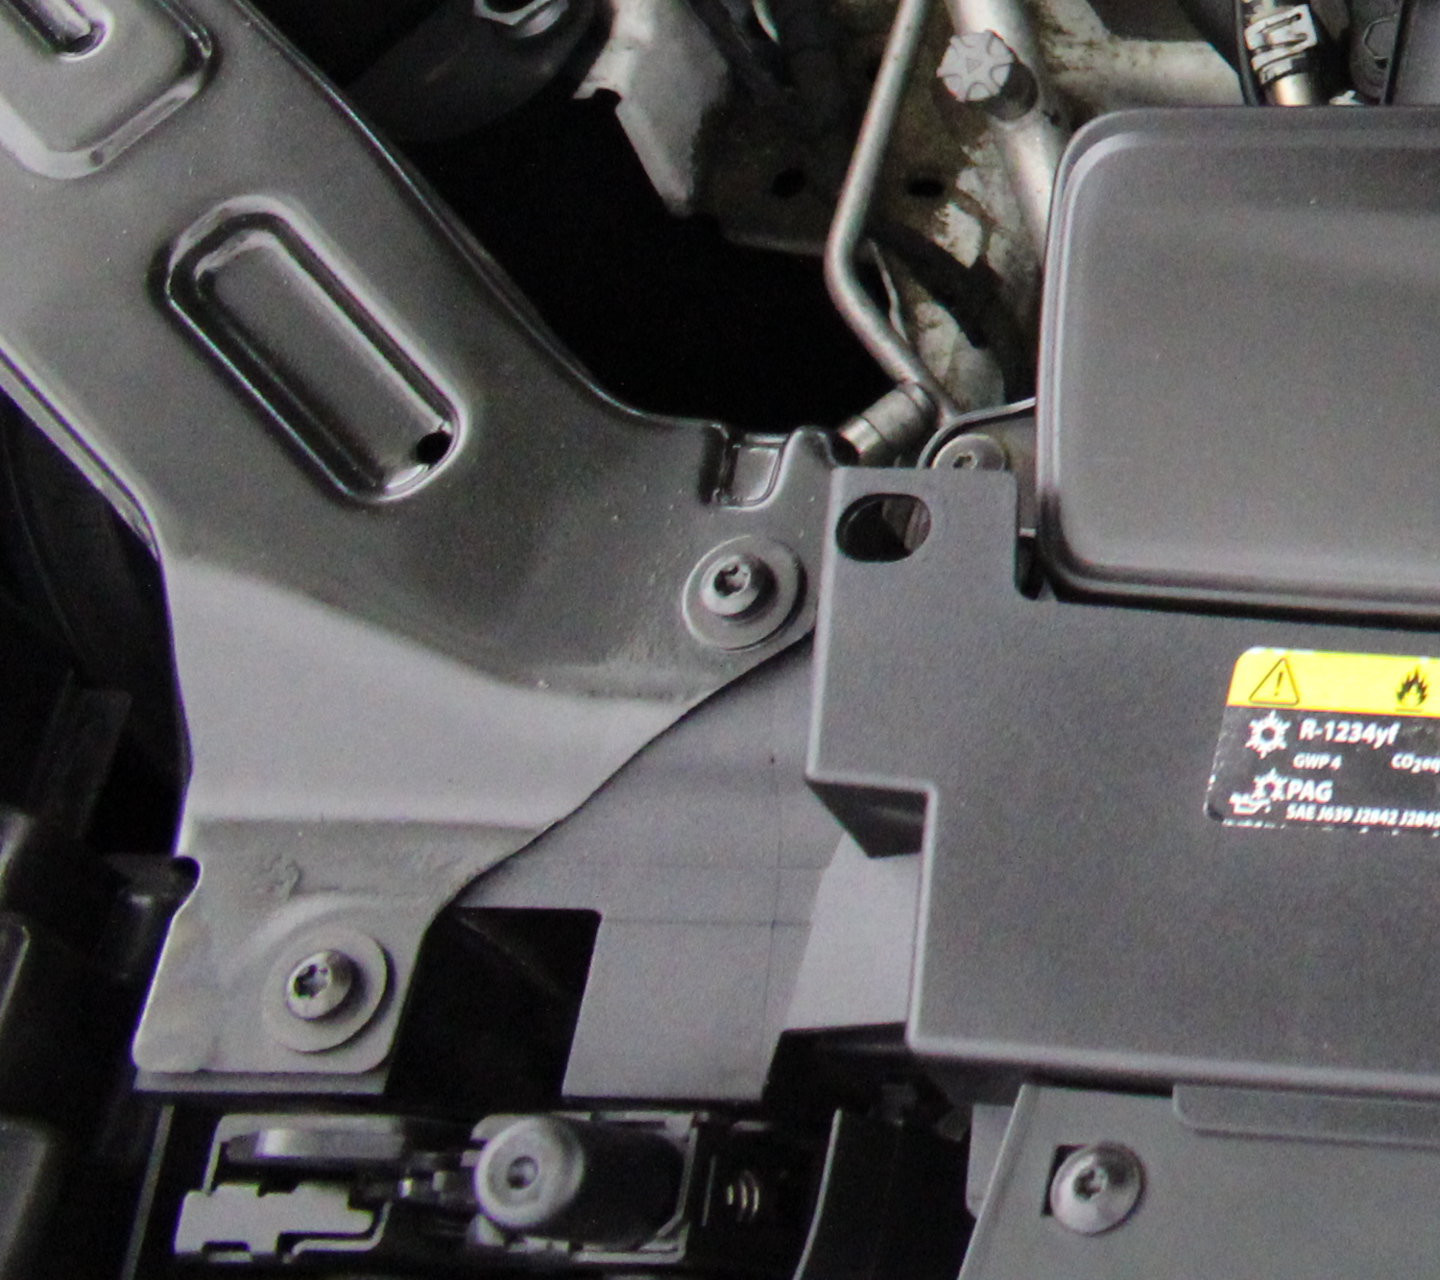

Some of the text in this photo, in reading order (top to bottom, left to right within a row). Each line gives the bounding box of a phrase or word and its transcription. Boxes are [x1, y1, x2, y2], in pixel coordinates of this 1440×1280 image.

[1299, 718, 1400, 749] R-1234yf
[1293, 753, 1342, 770] GWP 4
[1287, 779, 1333, 803] PAG
[1286, 803, 1314, 821] SAE
[1316, 806, 1352, 824] J639
[1353, 807, 1399, 826] J2842
